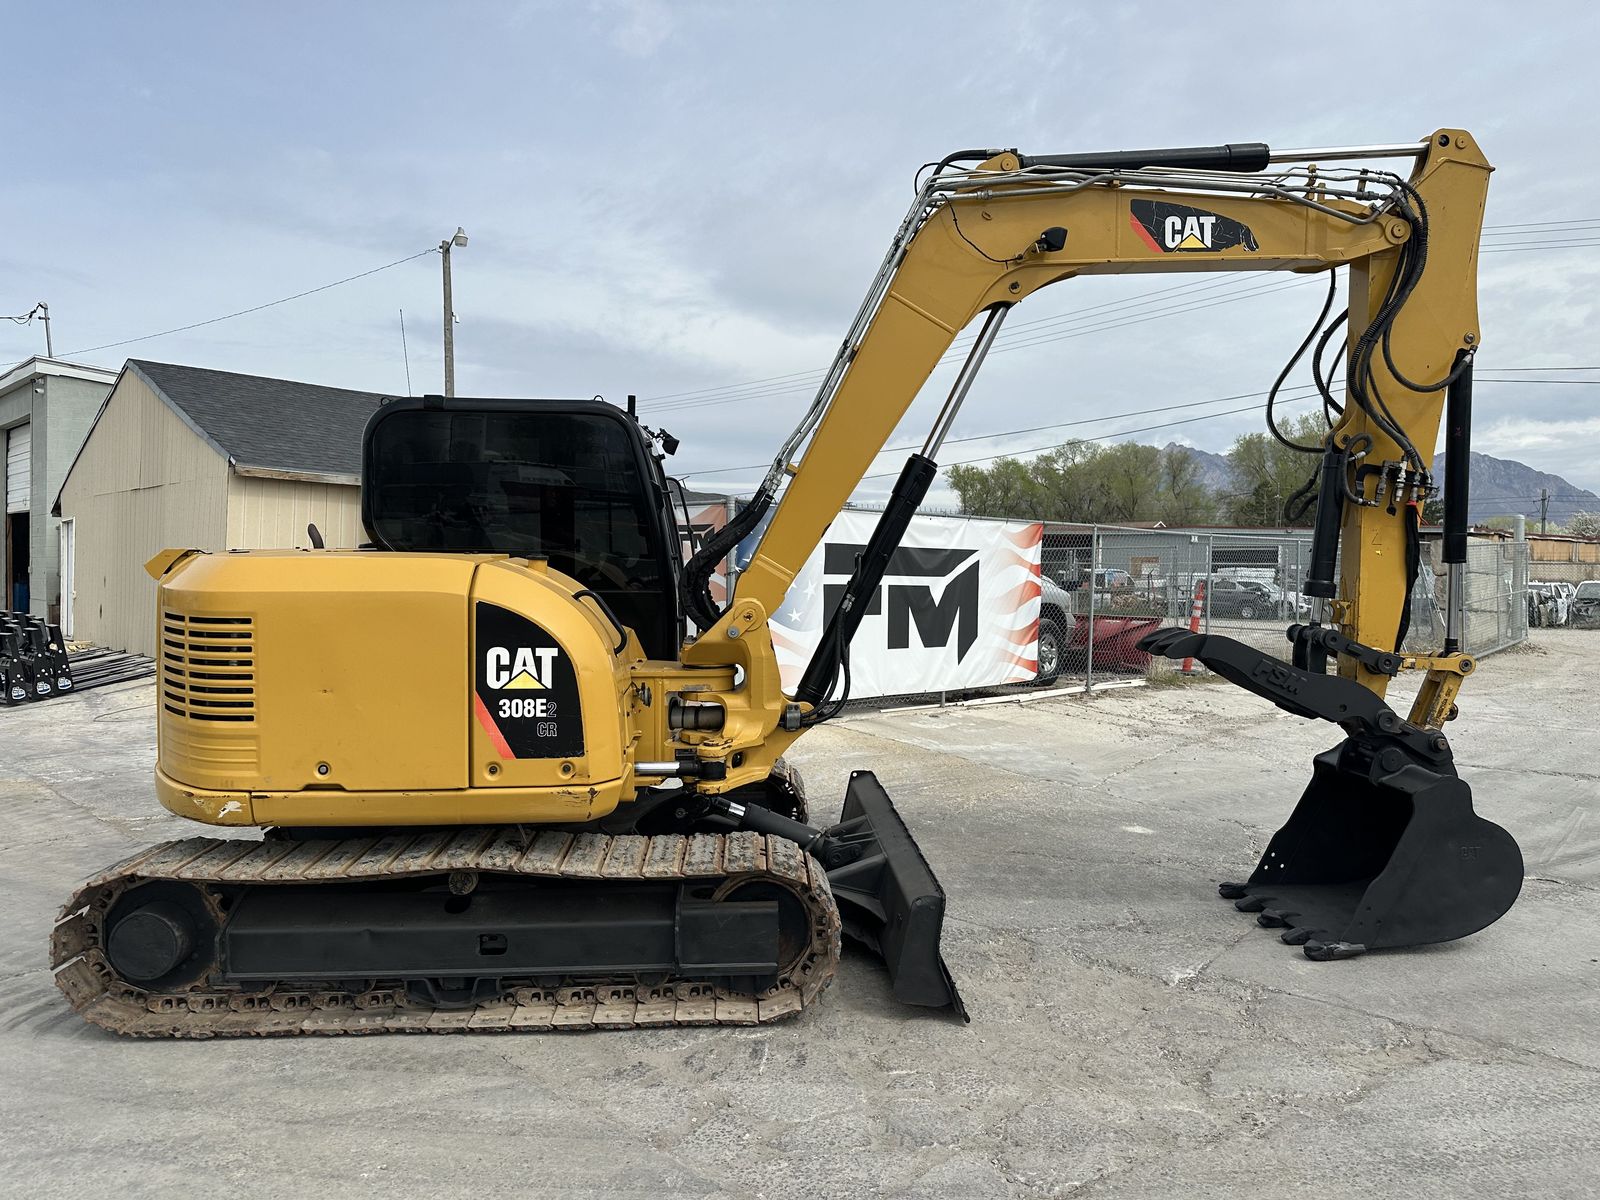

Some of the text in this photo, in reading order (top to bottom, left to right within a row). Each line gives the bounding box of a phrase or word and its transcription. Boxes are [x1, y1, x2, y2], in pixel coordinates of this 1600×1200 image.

[1164, 215, 1216, 249] CAT
[486, 646, 559, 690] CAT
[536, 722, 558, 737] CR
